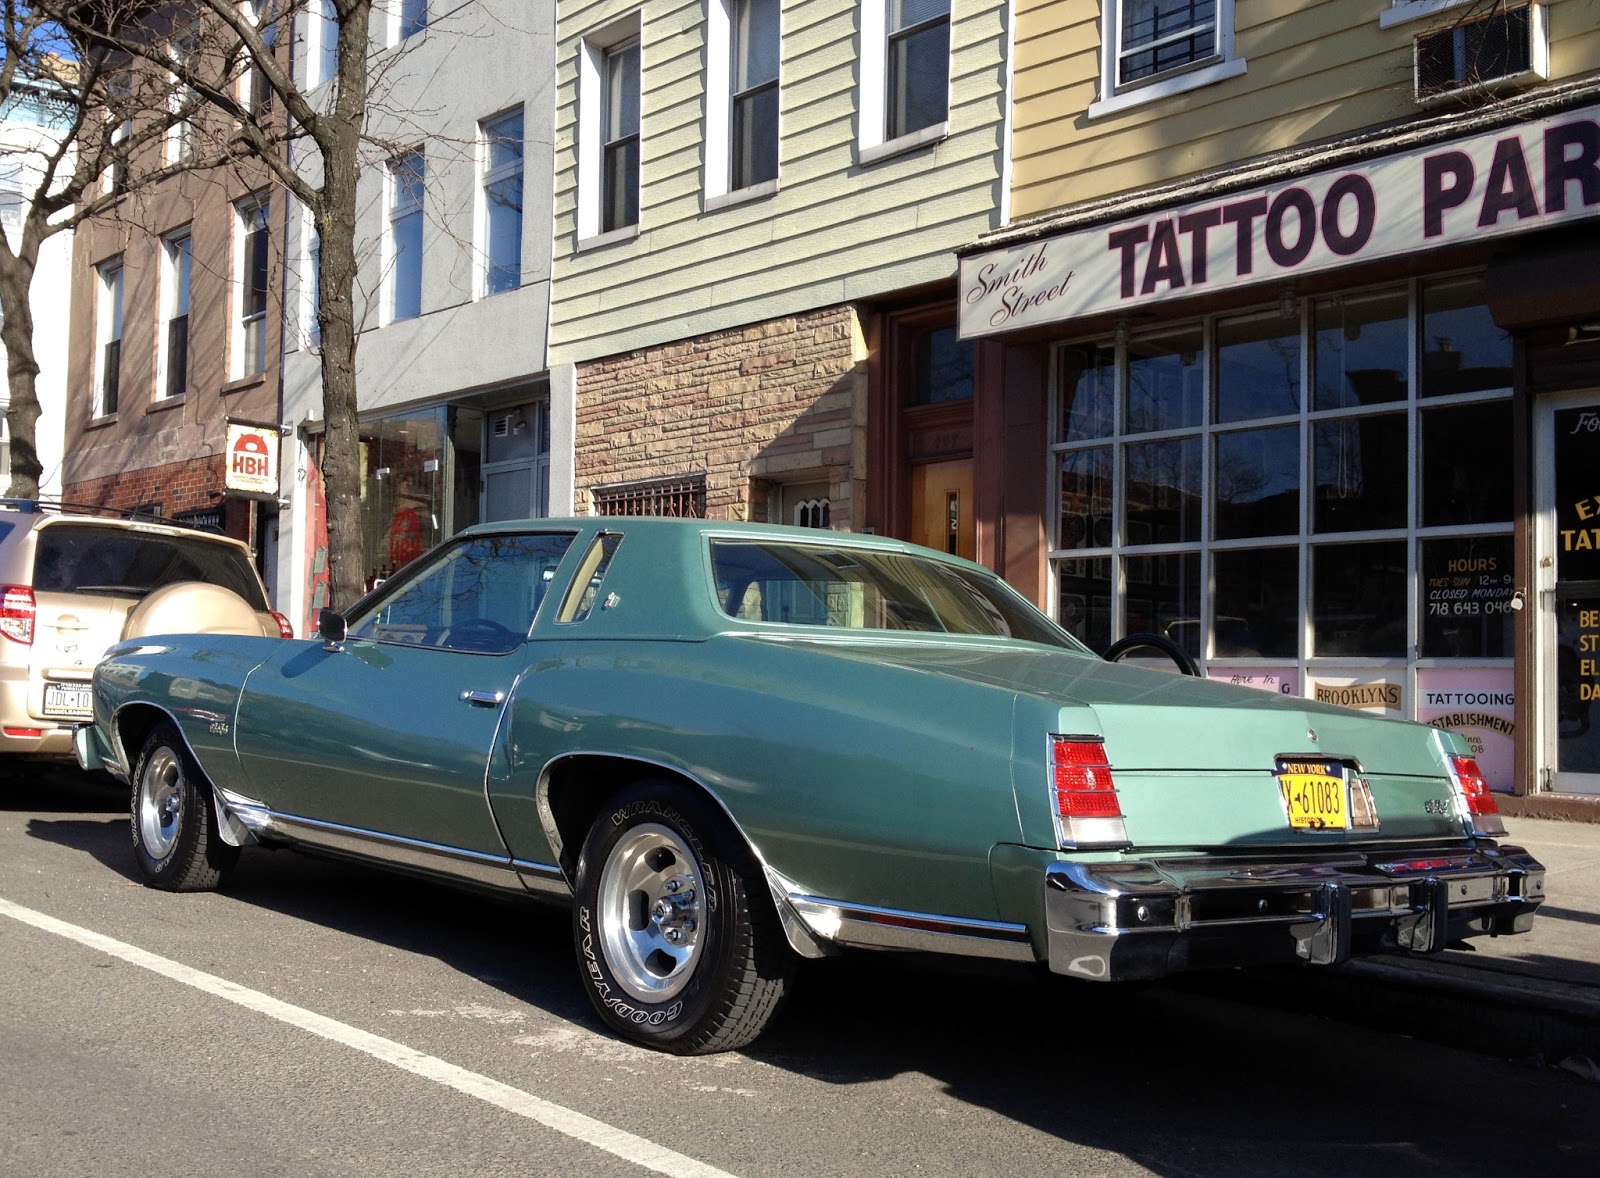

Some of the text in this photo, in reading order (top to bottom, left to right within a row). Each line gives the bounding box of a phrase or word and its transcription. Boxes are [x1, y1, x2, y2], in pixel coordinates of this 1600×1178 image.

[1108, 119, 1600, 300] TATTOO PAR
[967, 243, 1048, 304] Smith
[990, 271, 1075, 326] Street
[233, 452, 268, 476] HBH
[1448, 558, 1497, 572] HOURS
[1430, 589, 1468, 599] CLOSED
[1429, 602, 1449, 615] 718
[1453, 602, 1480, 615] 643
[47, 691, 69, 706] JDL
[1427, 693, 1514, 705] TATTOOING
[1461, 734, 1482, 744] ince
[1287, 763, 1327, 775] NEW YORK
[579, 905, 683, 1025] GOODYEAR
